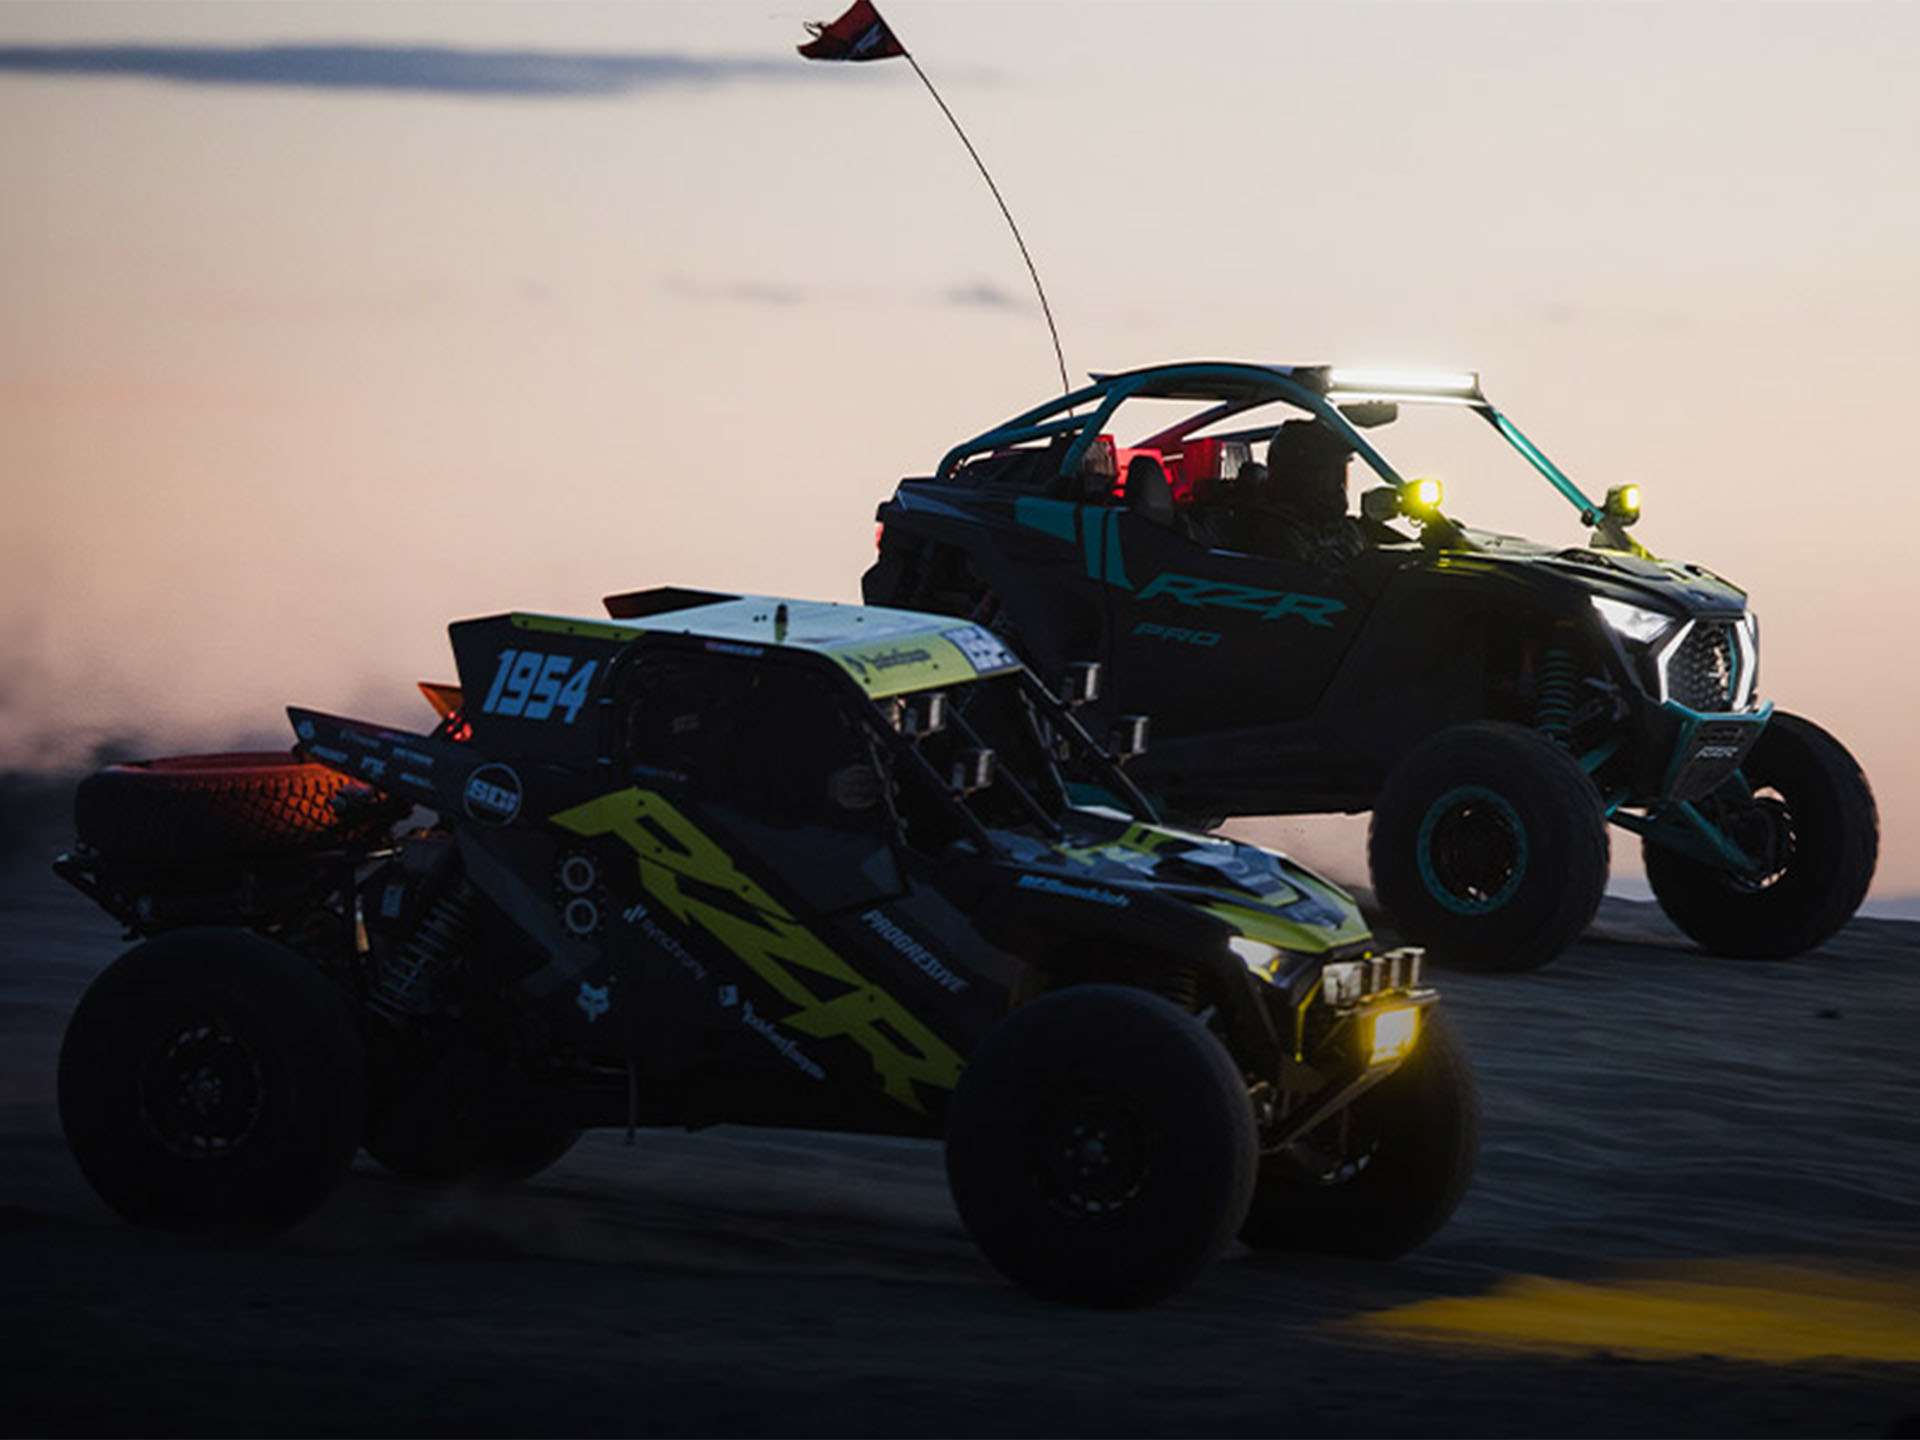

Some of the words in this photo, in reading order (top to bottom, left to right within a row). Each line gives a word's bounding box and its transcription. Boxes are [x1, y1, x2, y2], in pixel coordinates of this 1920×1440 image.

[1131, 621, 1222, 647] PRO
[1133, 572, 1348, 628] RZR
[482, 647, 599, 725] 1954
[549, 786, 967, 1116] RZR
[861, 908, 968, 995] PROGRESSIVE
